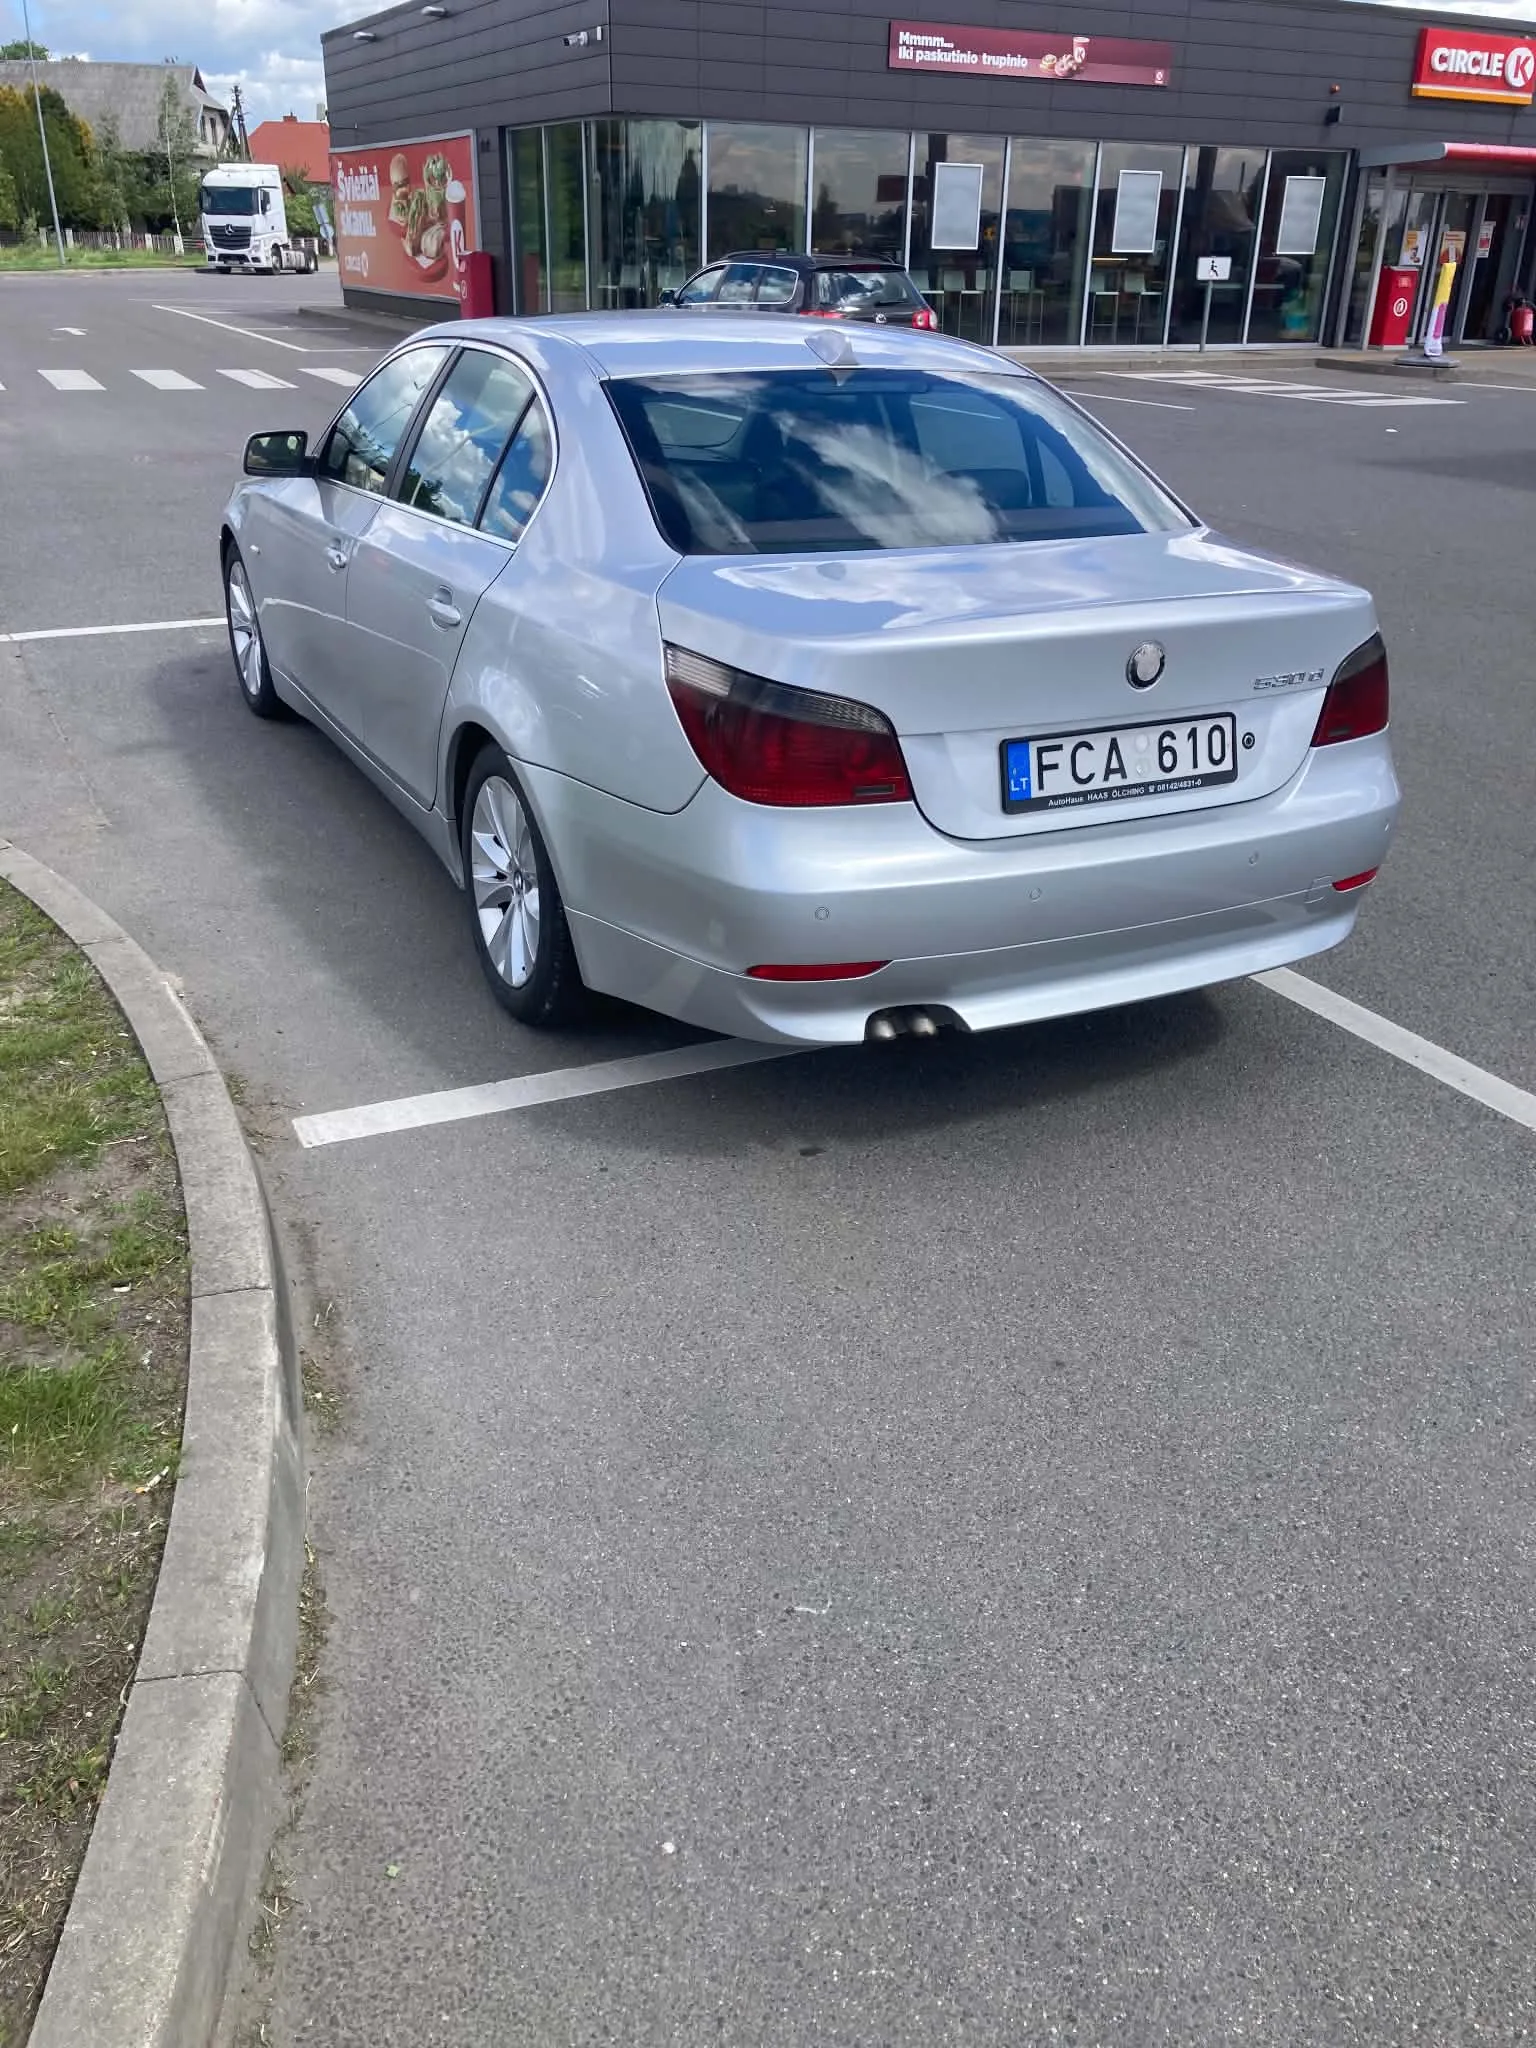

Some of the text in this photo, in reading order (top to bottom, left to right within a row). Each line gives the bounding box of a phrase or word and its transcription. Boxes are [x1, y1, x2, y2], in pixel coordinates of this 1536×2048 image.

[898, 46, 1028, 69] Iki paskutinio trupinio
[1430, 47, 1534, 87] CIRCLE K
[1036, 723, 1226, 792] FCA 610
[1010, 777, 1030, 792] LT
[1087, 791, 1109, 801] HAAS
